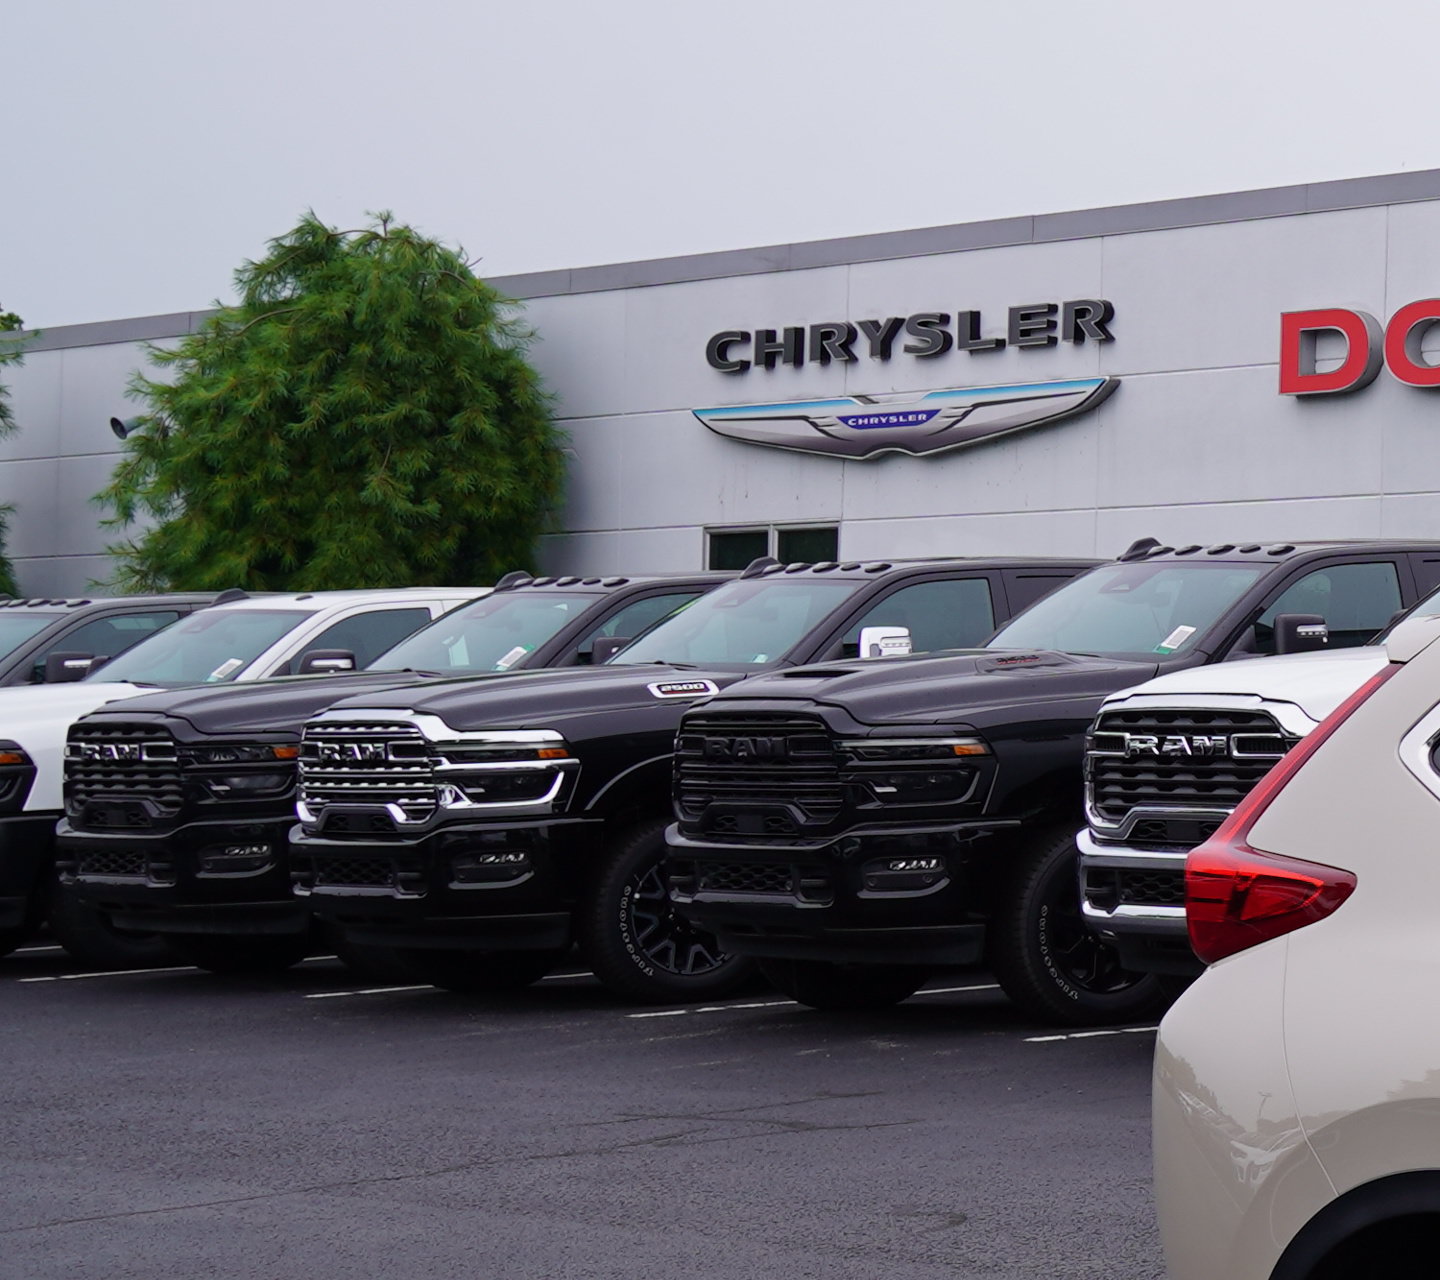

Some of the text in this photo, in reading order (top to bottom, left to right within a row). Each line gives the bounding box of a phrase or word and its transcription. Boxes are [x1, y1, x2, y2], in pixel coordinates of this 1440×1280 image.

[706, 299, 1116, 373] CHRYSLER
[848, 413, 928, 426] CHRYSLER
[660, 682, 705, 692] 2500
[81, 742, 140, 761] RAM
[319, 742, 386, 761] RAM
[704, 736, 788, 758] RAM
[1129, 734, 1228, 756] RAM
